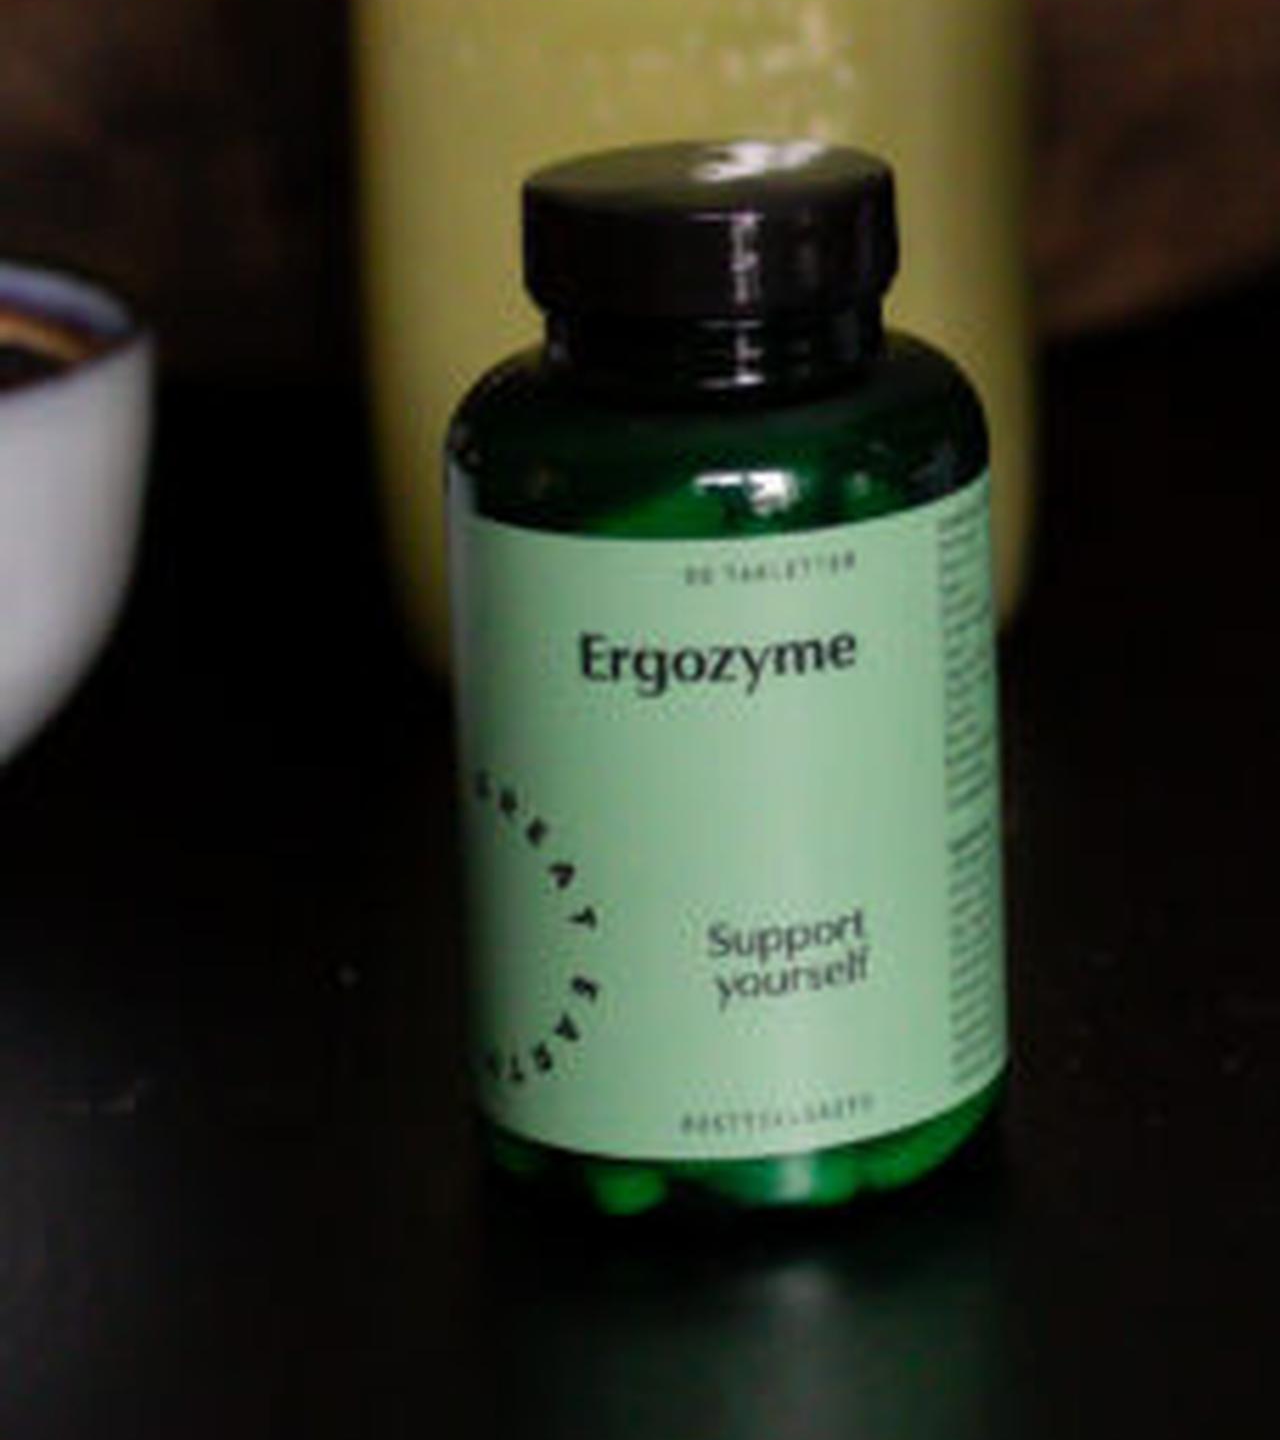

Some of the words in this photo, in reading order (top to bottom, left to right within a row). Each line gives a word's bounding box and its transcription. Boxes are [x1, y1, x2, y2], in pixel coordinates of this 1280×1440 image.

[578, 630, 857, 699] Ergozyme
[707, 908, 863, 967] Support
[714, 943, 871, 1015] yourself
